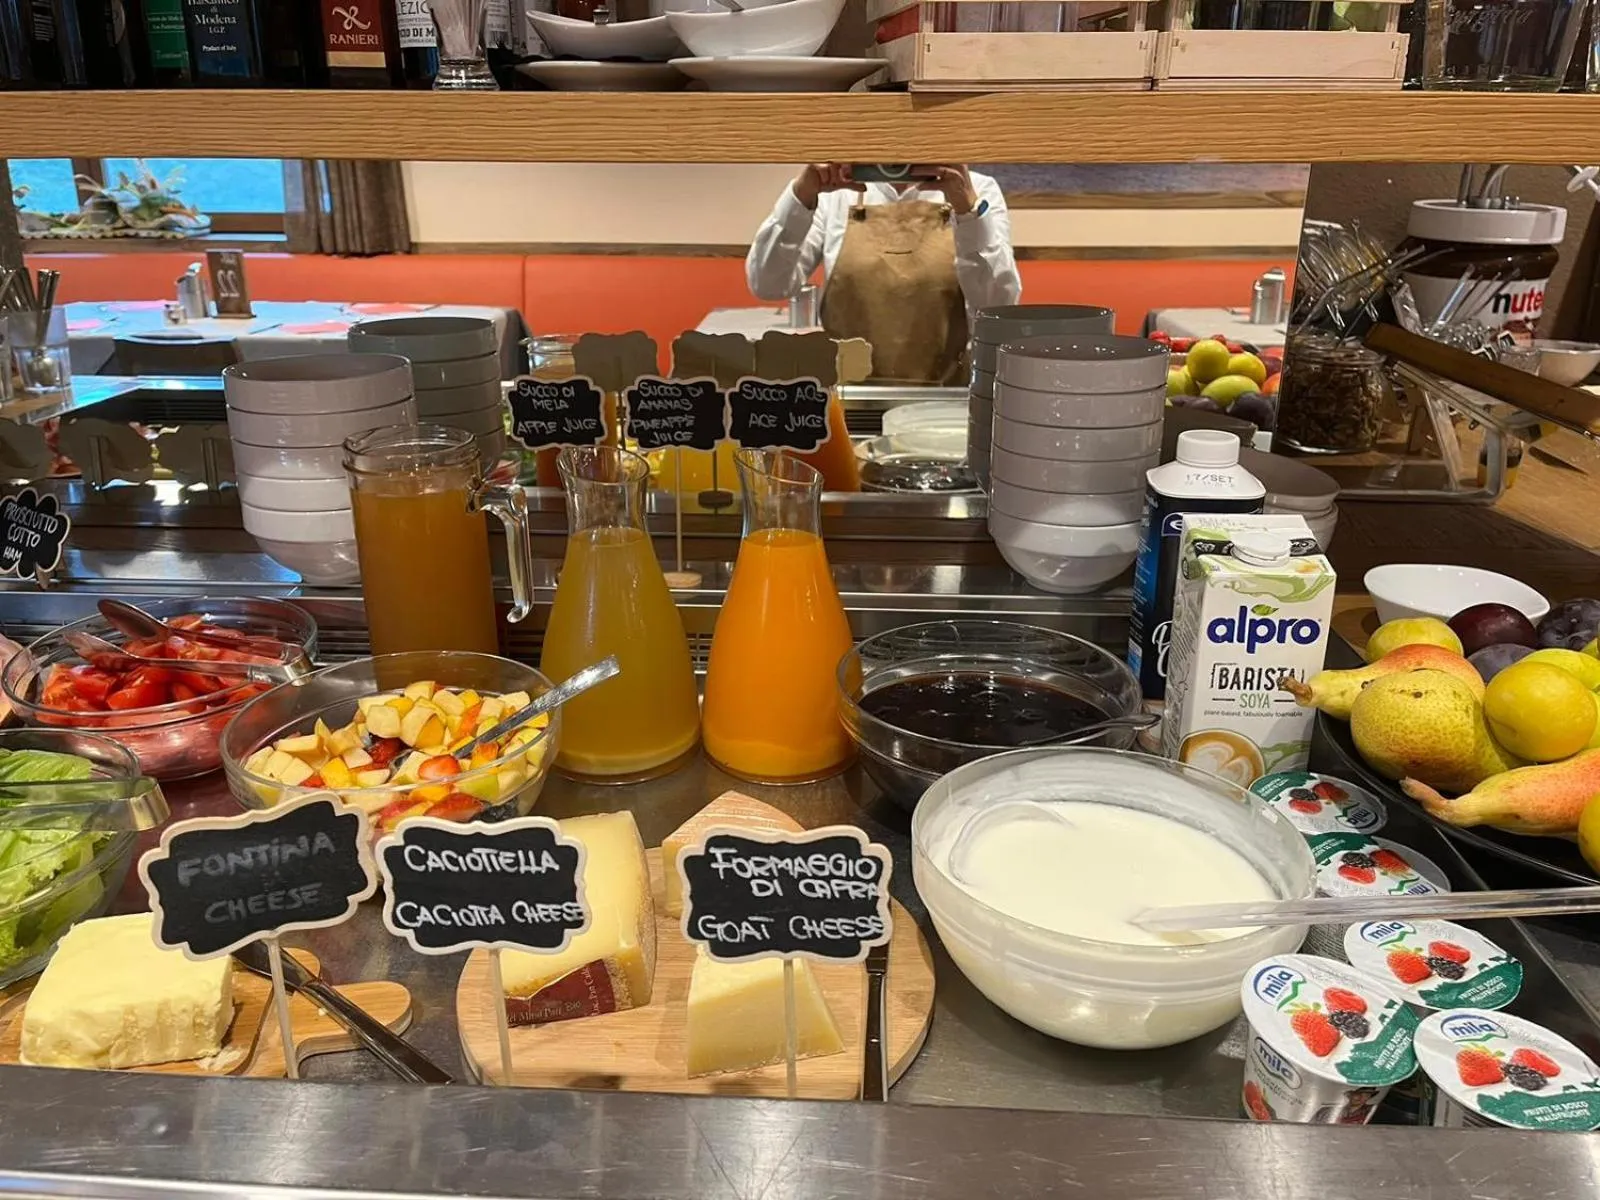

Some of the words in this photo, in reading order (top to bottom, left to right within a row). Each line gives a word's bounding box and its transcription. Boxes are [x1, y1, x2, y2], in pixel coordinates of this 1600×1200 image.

[195, 14, 238, 25] Modena
[329, 33, 379, 45] RANIERI
[519, 382, 558, 398] SUCCO
[639, 382, 682, 398] SUCCO
[742, 383, 787, 401] SUCCO
[532, 398, 570, 412] MELA
[517, 420, 557, 436] APPLE
[563, 417, 598, 434] JUICE
[784, 411, 824, 433] JUICE
[649, 431, 694, 445] JUICE
[3, 502, 59, 534] PROSCIUTTO
[7, 523, 41, 548] COTTO
[3, 546, 24, 562] HAM
[1206, 604, 1321, 654] alpro
[1239, 693, 1271, 709] SOYA
[708, 847, 878, 880] FORMAGGIO
[751, 879, 784, 897] DI
[798, 878, 880, 900] CAPRA
[204, 882, 323, 924] CHEESE
[396, 901, 505, 928] CACIOTTA
[511, 900, 585, 925] CHEESE
[697, 914, 775, 943] GOAT
[789, 914, 885, 940] CHEESE
[1368, 921, 1405, 940] mila
[1262, 970, 1294, 999] mila
[1448, 1022, 1497, 1037] mila
